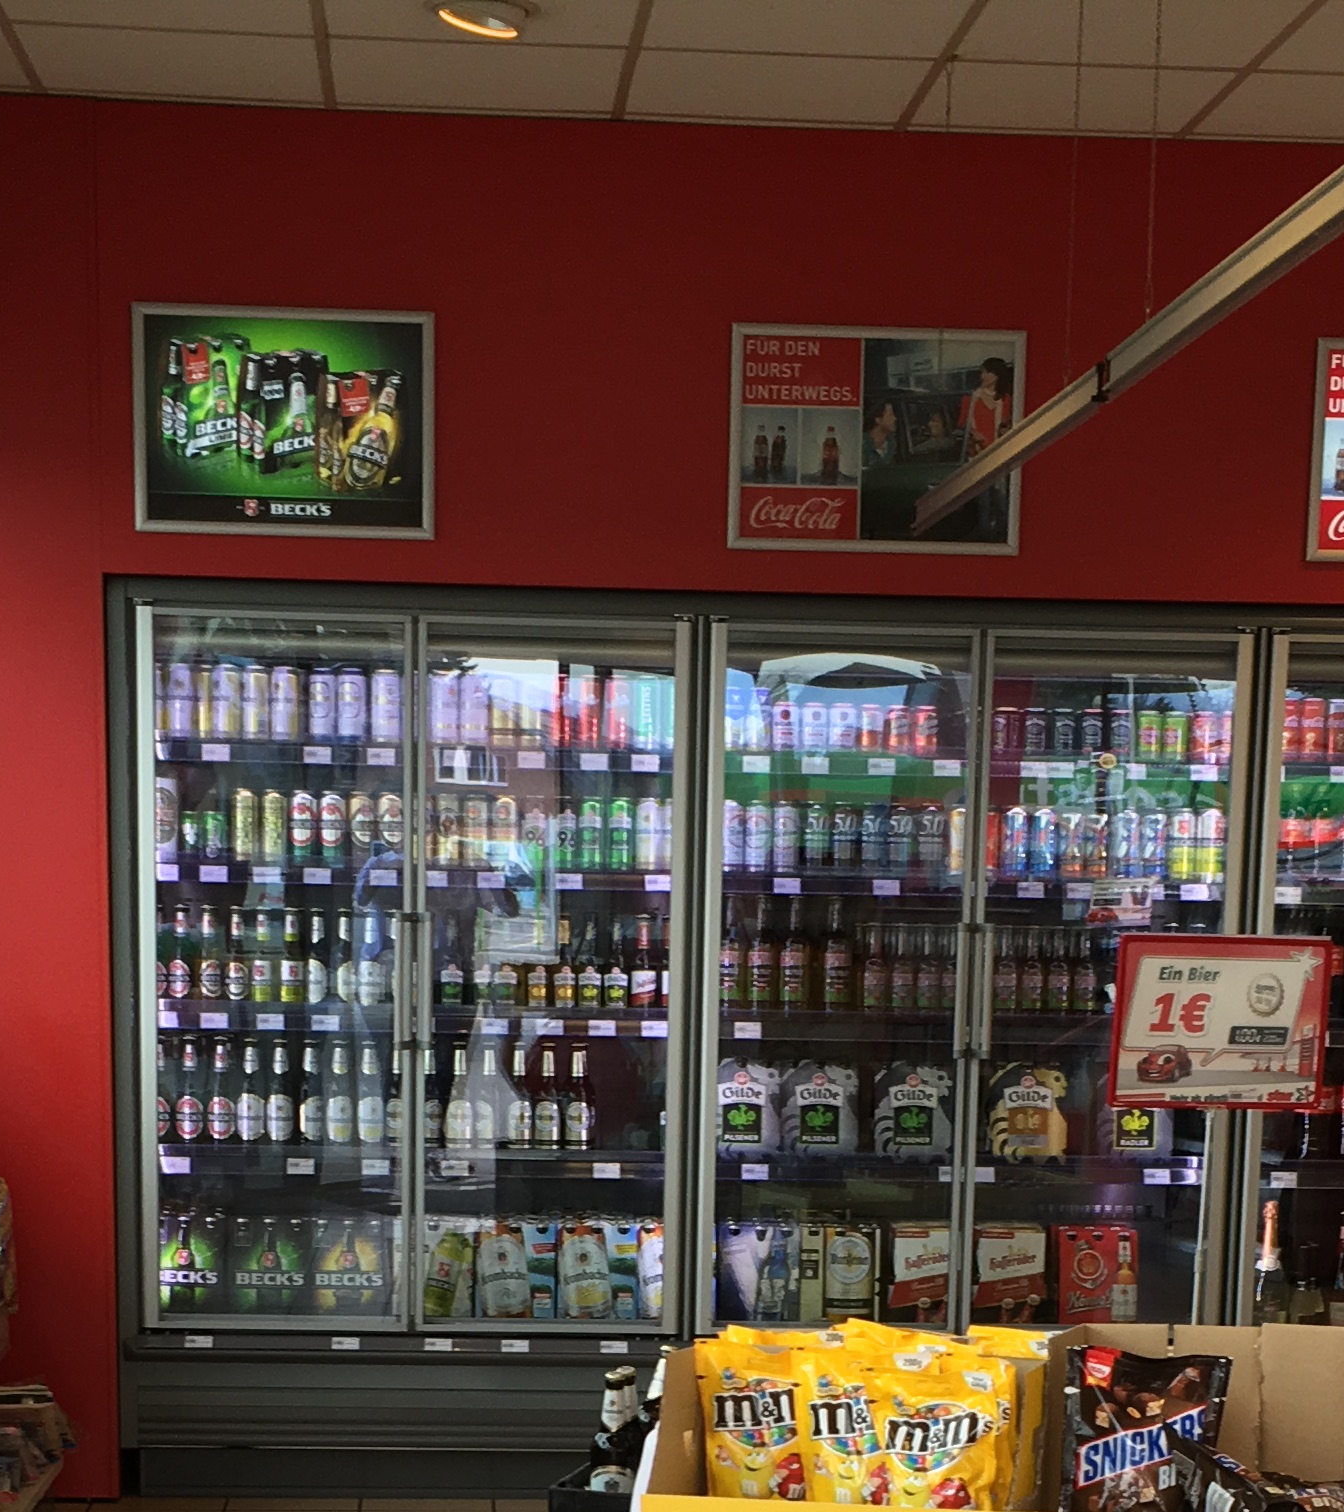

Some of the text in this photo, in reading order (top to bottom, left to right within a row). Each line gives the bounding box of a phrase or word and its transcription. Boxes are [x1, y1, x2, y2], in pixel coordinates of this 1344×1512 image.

[785, 341, 820, 356] DEN
[745, 362, 802, 377] DURST
[745, 384, 857, 401] UNTERWEGS.
[196, 416, 237, 436] BECK
[273, 436, 316, 455] BECK
[270, 502, 332, 518] BECK'S
[749, 496, 846, 530] Coca-Cola
[1158, 966, 1220, 982] Ein Bier
[1148, 992, 1213, 1034] 1€
[722, 1086, 763, 1100] Gilde
[799, 1087, 841, 1101] Gilde
[893, 1089, 935, 1102] Gilde
[1008, 1090, 1049, 1103] Gilde
[235, 1272, 305, 1286] BECK'S
[315, 1273, 384, 1286] BECK'S
